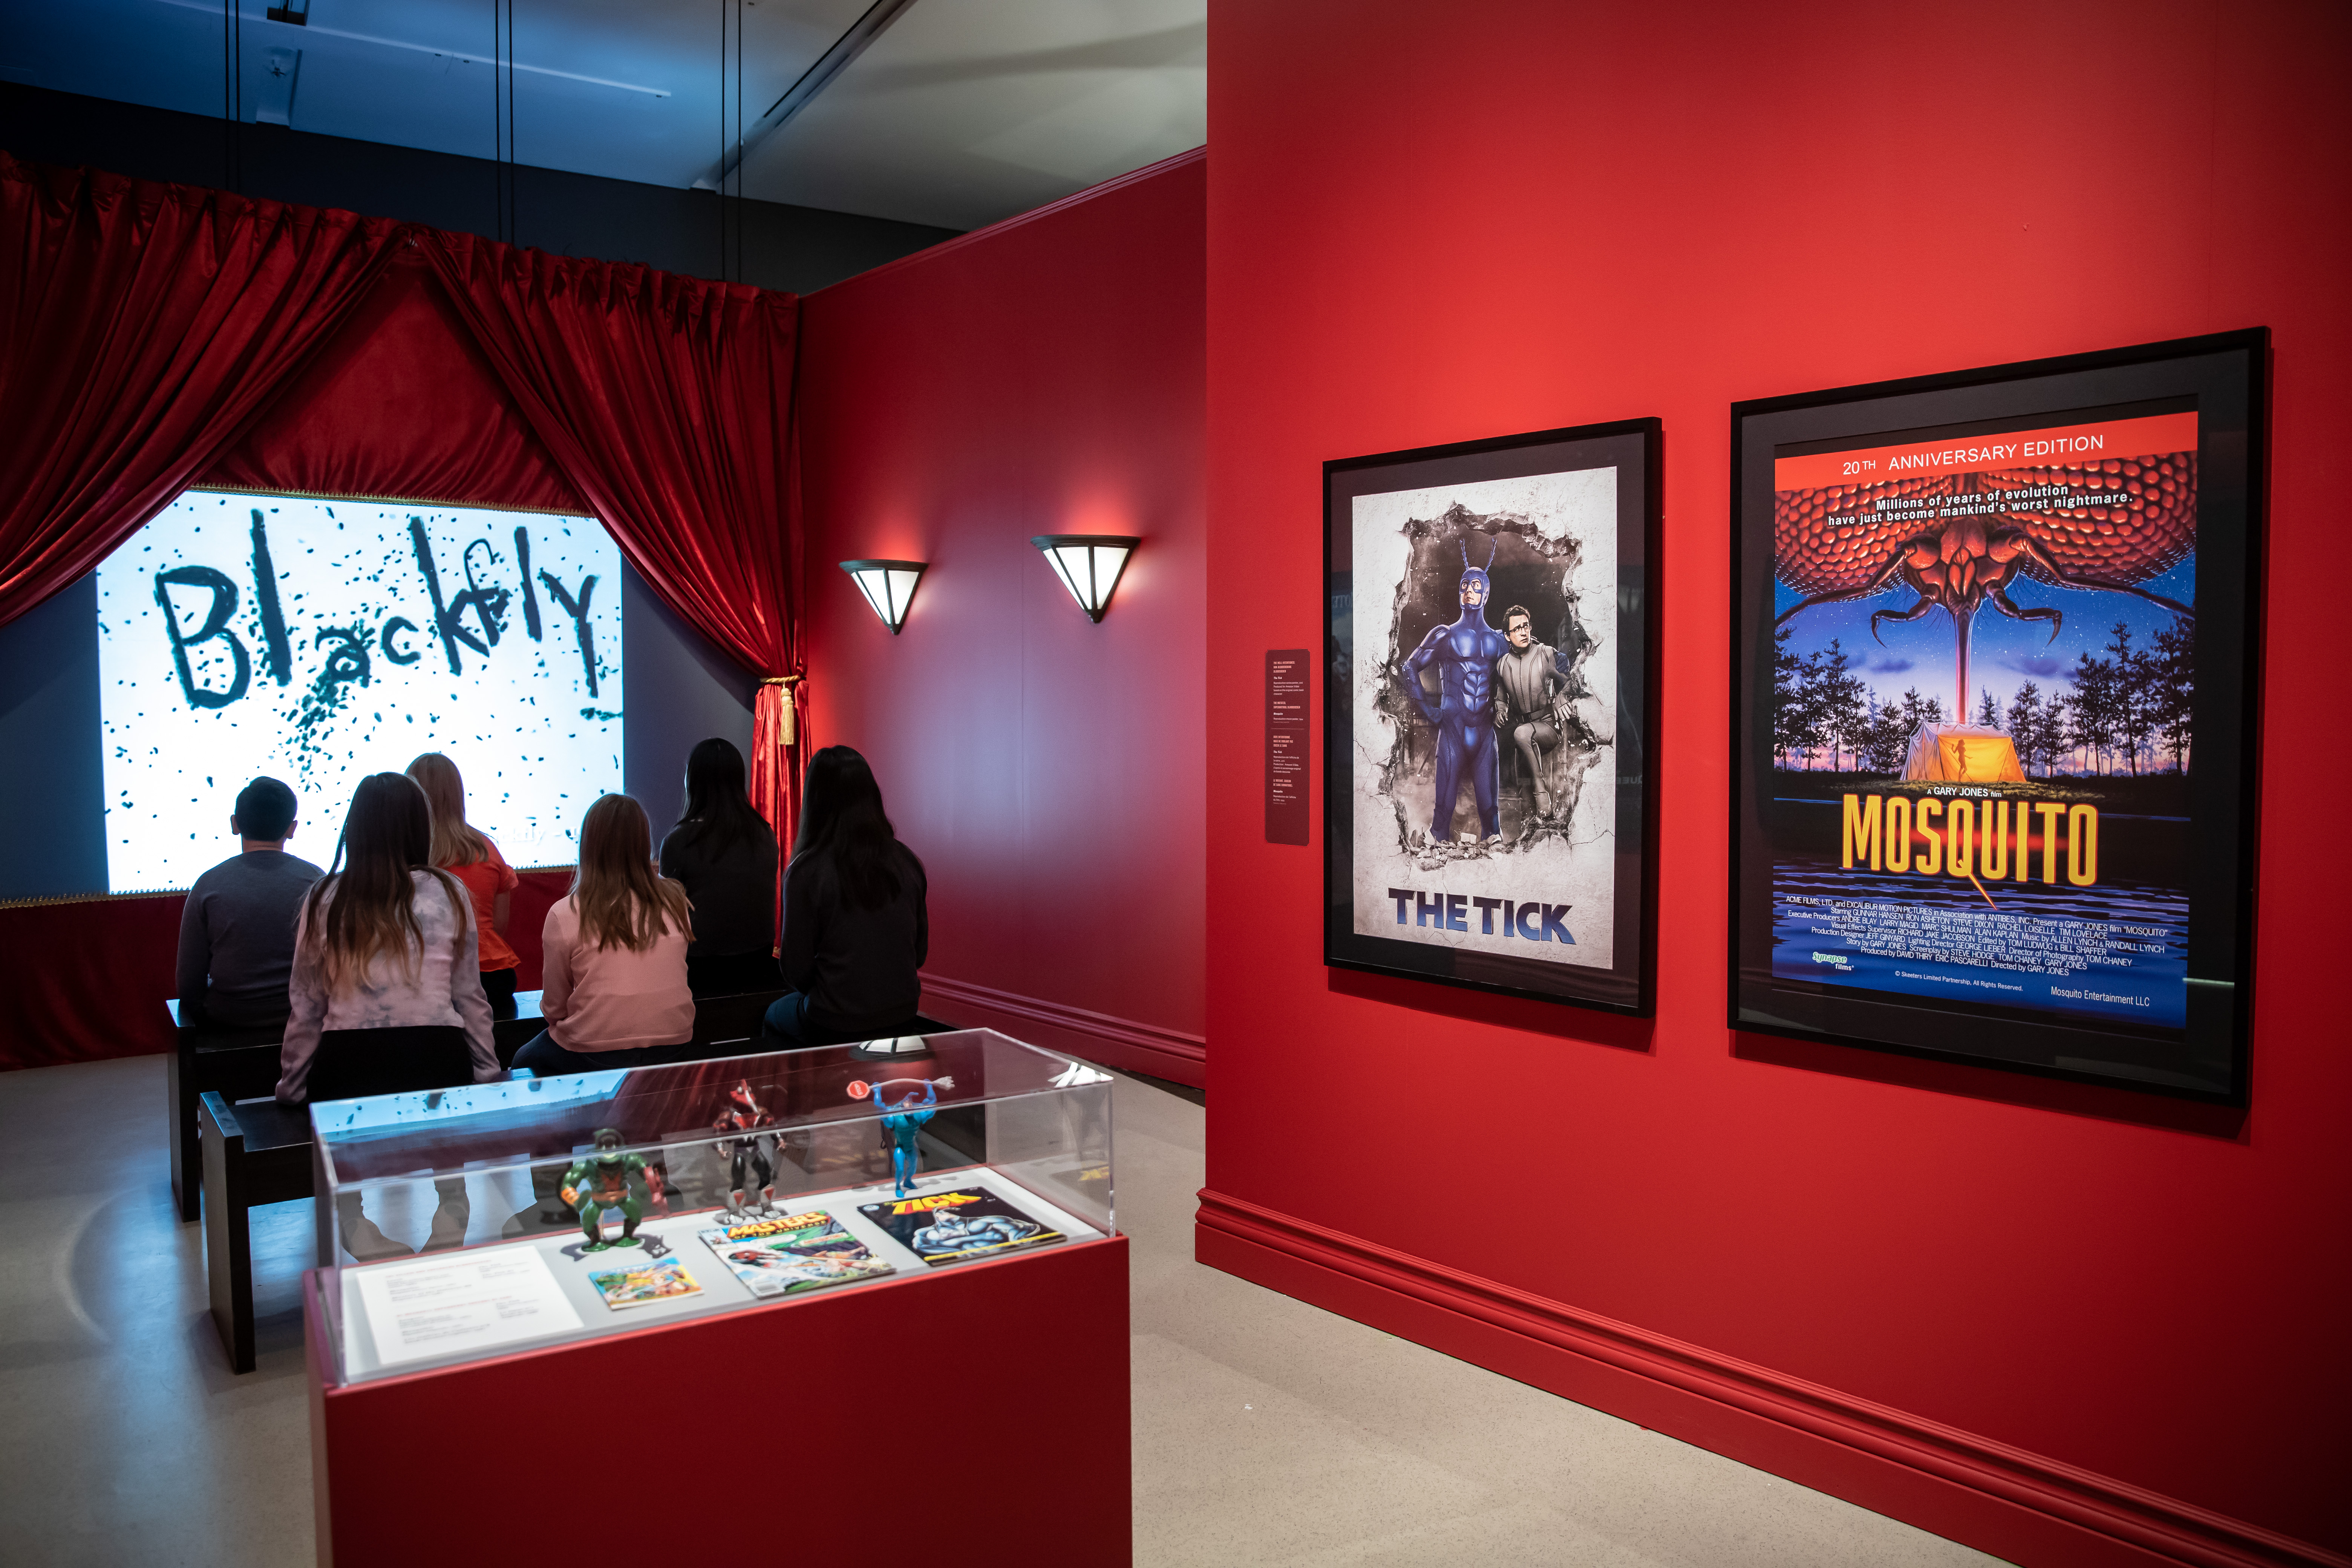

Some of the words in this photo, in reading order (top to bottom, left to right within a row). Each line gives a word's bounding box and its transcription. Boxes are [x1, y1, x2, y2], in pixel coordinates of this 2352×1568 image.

[1888, 444, 2016, 470] ANNIVERSARY
[2024, 435, 2102, 456] EDITION
[1828, 514, 1854, 525] have
[1859, 512, 1882, 525] just
[1887, 508, 1934, 521] become
[2011, 499, 2048, 511] worst
[2054, 491, 2133, 509] nightmare.
[1876, 497, 1925, 511] Millions
[1929, 495, 1940, 506] of
[1946, 493, 1981, 506] years
[1987, 490, 1999, 501] of
[2004, 484, 2067, 500] evolution
[1934, 787, 1957, 796] GARY
[1959, 787, 1988, 797] JONES
[1842, 793, 2098, 910] MOSQUITO
[1388, 887, 1468, 932] THE
[1472, 896, 1577, 945] TICK
[1803, 897, 1820, 905] FILMS,
[1846, 901, 1877, 910] EXCALIBUR
[1879, 904, 1902, 912] MOTION
[1903, 906, 1932, 915] PICTURES
[1940, 910, 1972, 919] Association
[1988, 914, 2016, 923] ANTIBES,
[2033, 918, 2057, 926] Present
[2064, 920, 2083, 929] GARY
[2084, 922, 2108, 931] JONES
[1830, 907, 1851, 916] Starring
[1853, 909, 1877, 917] GUNNAR
[1879, 911, 1903, 920] HANSEN
[1920, 916, 1949, 924] ASHETON
[1997, 922, 2023, 931] RACHEL
[2024, 925, 2055, 934] LOISELLE
[2072, 929, 2108, 939] LOVELACE
[1811, 927, 1839, 936] Production
[1841, 930, 1864, 939] Designer
[1880, 934, 1905, 942] GINYARD
[1908, 937, 1930, 946] Lighting
[1931, 939, 1954, 948] Director
[1956, 942, 1982, 951] GEORGE
[1983, 944, 2005, 953] LIEBER
[2009, 947, 2034, 956] Director
[2043, 950, 2084, 962] Photography
[2085, 955, 2101, 963] TOM
[2103, 957, 2132, 966] CHANEY
[1813, 913, 1840, 921] Producers
[1941, 925, 1971, 934] SHULMAN
[1993, 930, 2018, 939] KAPLAN
[2021, 933, 2040, 941] Music
[2041, 934, 2049, 943] by
[2050, 935, 2072, 944] ALLEN
[2074, 937, 2098, 946] LYNCH
[2105, 940, 2138, 950] RANDALL
[2139, 944, 2164, 953] LYNCH
[1867, 925, 1896, 935] Supervisor
[1898, 928, 1923, 937] RICHARD
[1941, 933, 1975, 942] JACOBSON
[1978, 936, 1997, 944] Edited
[1998, 938, 2006, 946] by
[2076, 946, 2107, 956] SHAFFER
[1812, 952, 1847, 964] Synapse
[1846, 938, 1860, 946] Story
[1886, 942, 1906, 950] JONES
[1909, 944, 1941, 955] Screenplay
[1942, 948, 1949, 956] by
[1951, 949, 1970, 957] STEVE
[1972, 951, 1995, 960] HODGE
[2014, 955, 2041, 965] CHANEY
[2045, 959, 2063, 967] GARY
[2064, 960, 2087, 969] JONES
[1861, 946, 1887, 955] Produced
[1950, 956, 1988, 966] PASCARELLI
[1991, 960, 2017, 969] Directed
[2018, 963, 2026, 972] by
[2027, 964, 2045, 973] GARY
[2046, 966, 2069, 975] JONES
[1942, 976, 1971, 986] Partnership,
[1981, 980, 1996, 989] Rights
[1998, 983, 2023, 991] Reserved.
[2051, 986, 2081, 999] Mosquito
[2084, 990, 2133, 1005] Entertainment
[2136, 996, 2149, 1007] LLC
[892, 1192, 982, 1215] TICK
[728, 1211, 829, 1237] MASTERS
